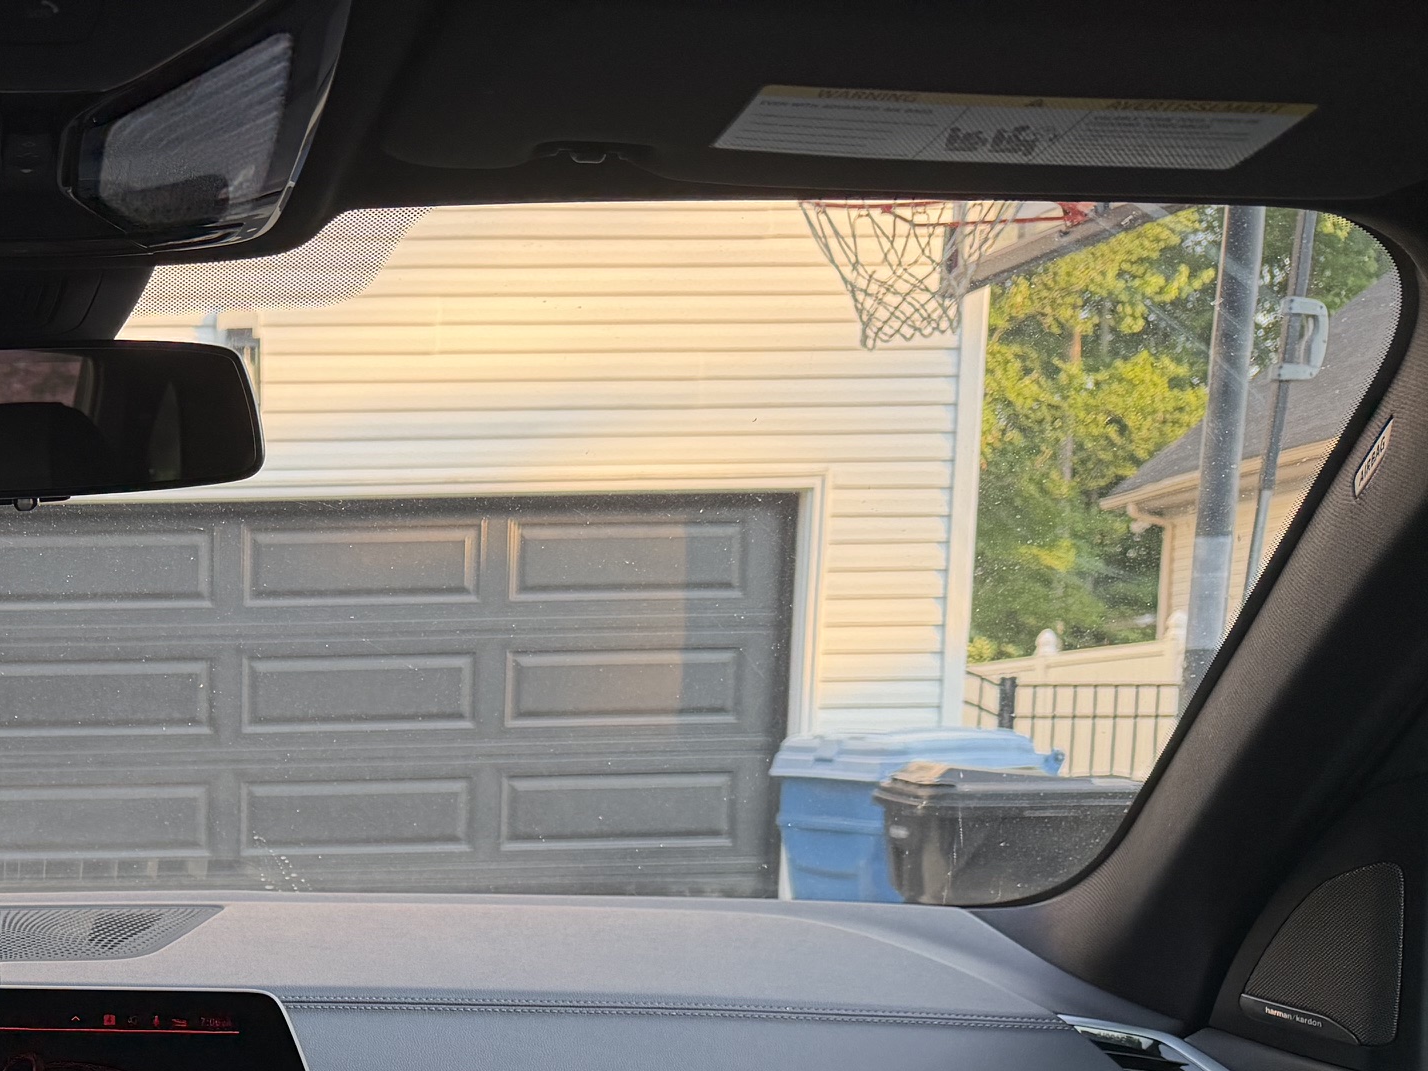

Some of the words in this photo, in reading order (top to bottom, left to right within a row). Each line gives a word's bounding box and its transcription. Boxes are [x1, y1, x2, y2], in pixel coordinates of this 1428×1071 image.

[818, 88, 918, 103] WARNING
[1358, 435, 1386, 487] AIRBAG
[1265, 1006, 1323, 1028] harman/kardon
